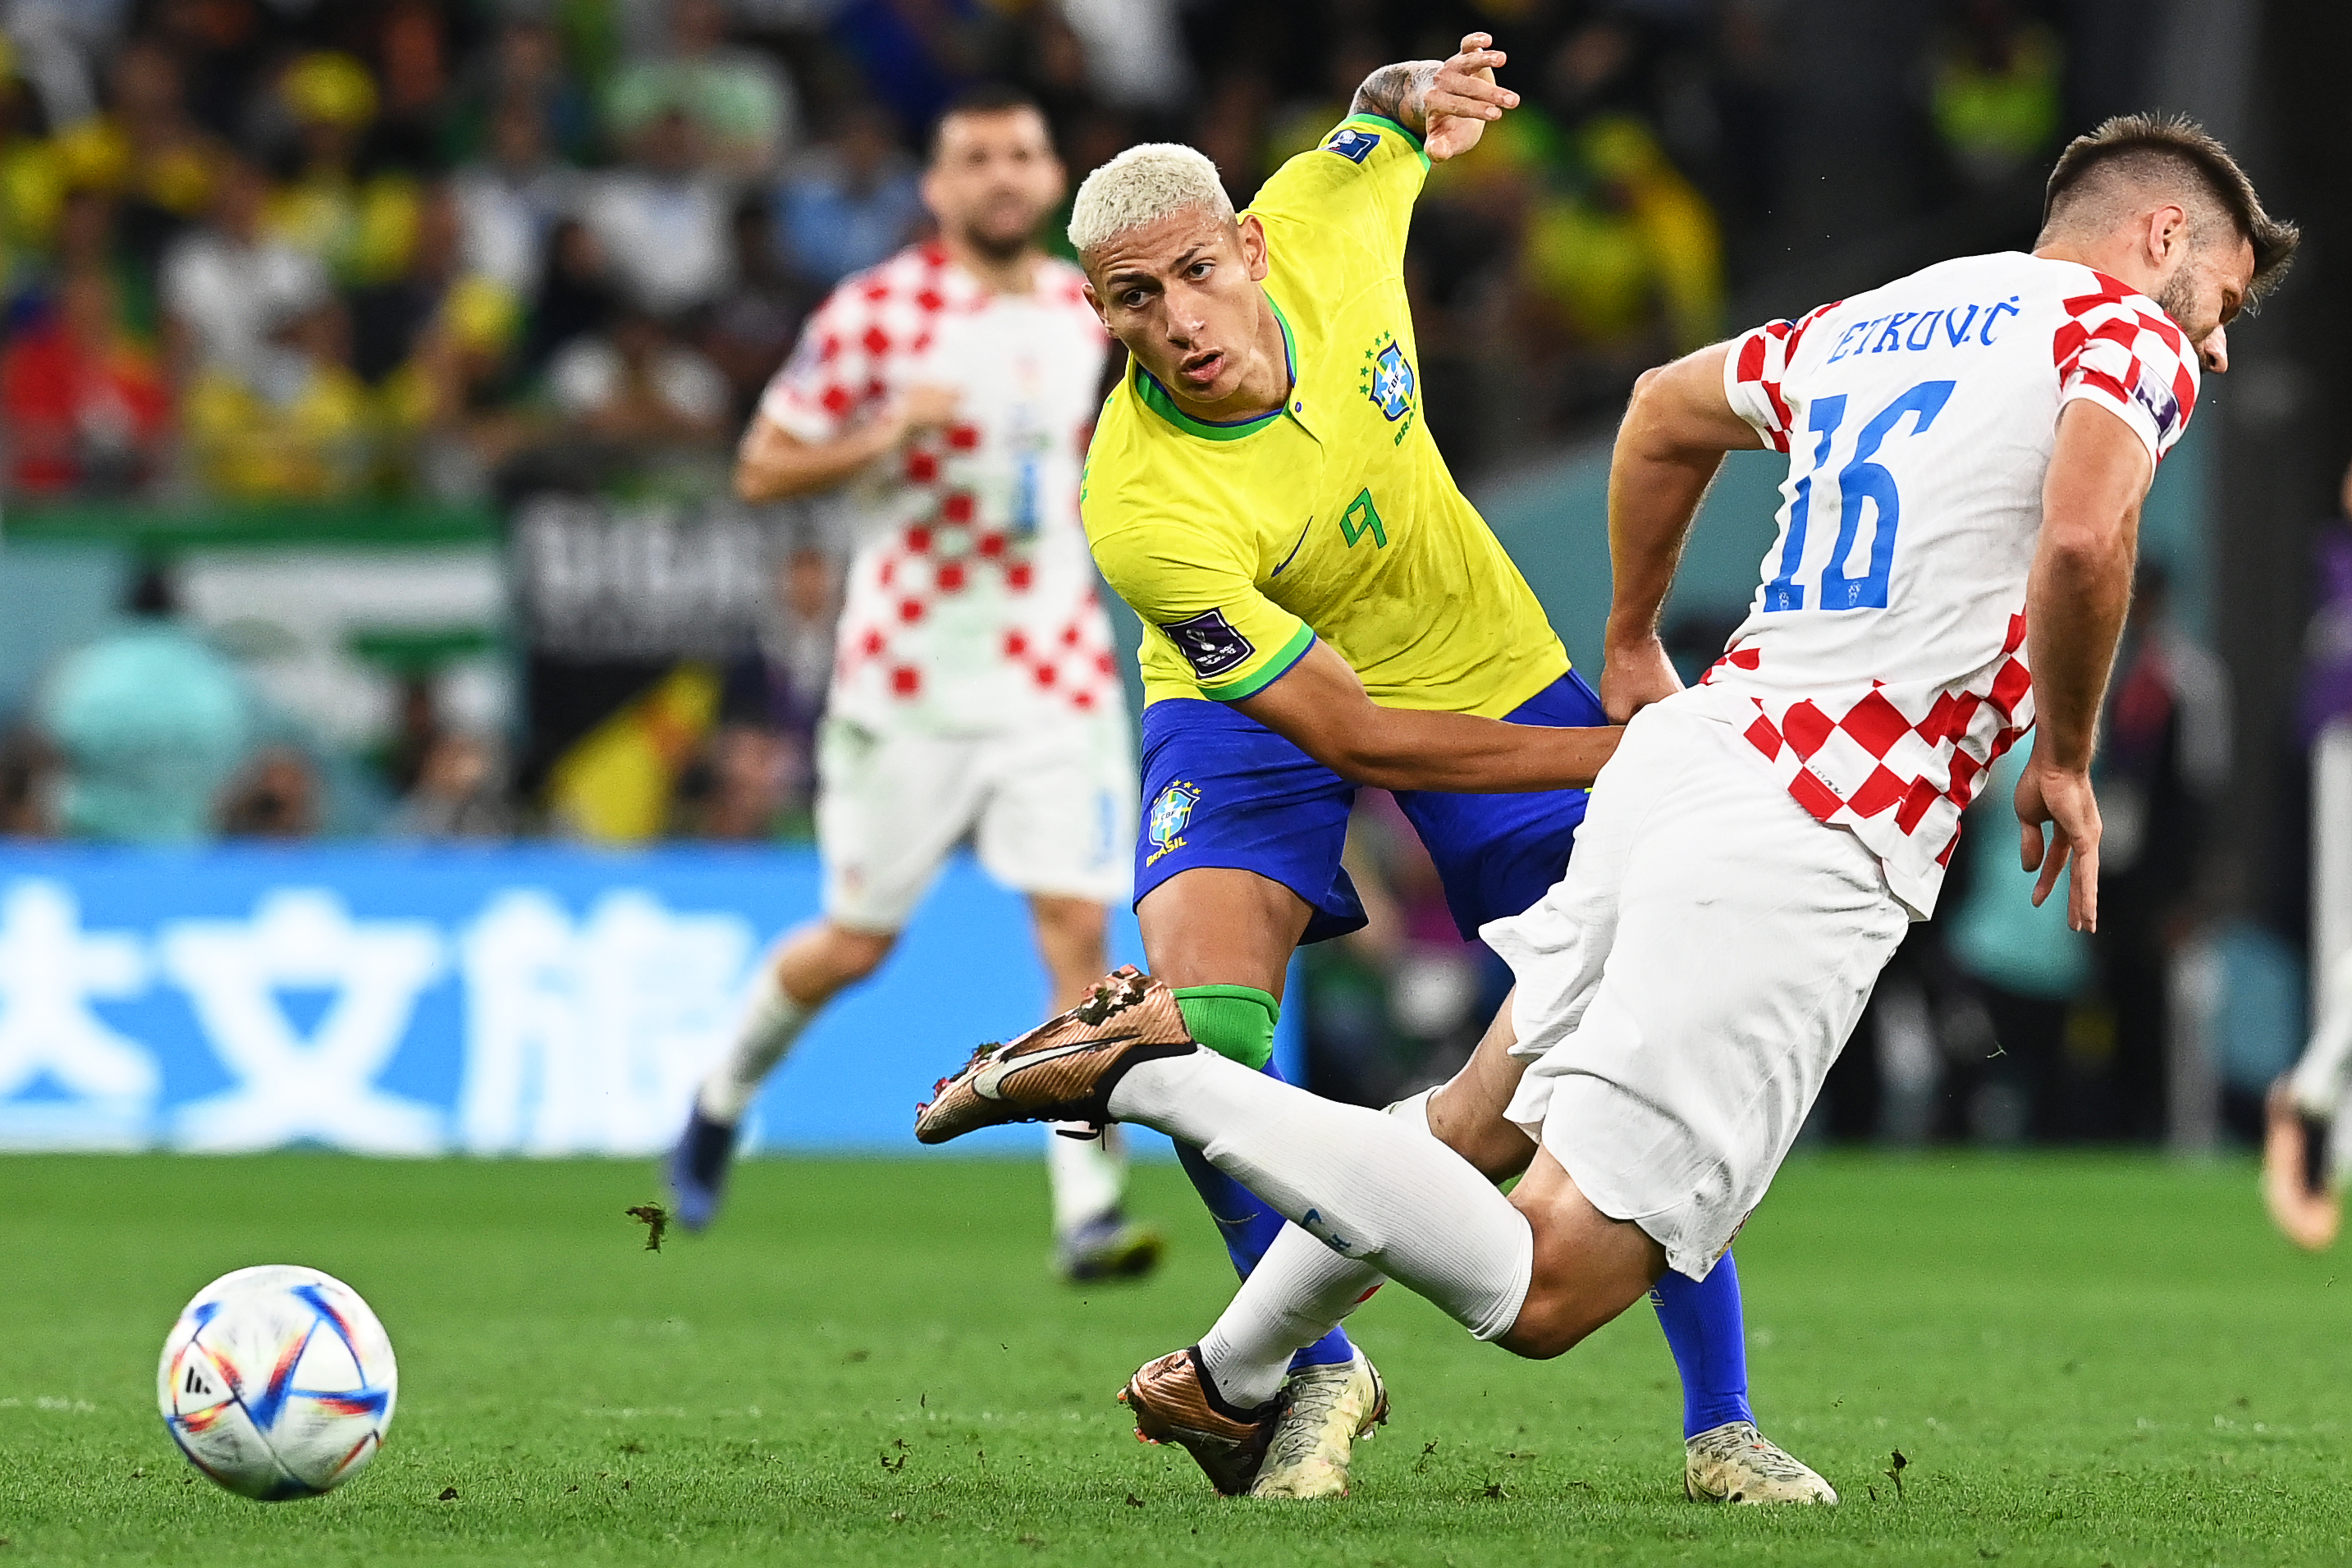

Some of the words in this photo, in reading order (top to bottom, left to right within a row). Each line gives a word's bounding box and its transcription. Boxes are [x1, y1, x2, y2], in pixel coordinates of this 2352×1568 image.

[1825, 295, 2020, 364] ETKOVĆ
[1338, 487, 1388, 550] 9
[1764, 380, 1957, 613] 16
